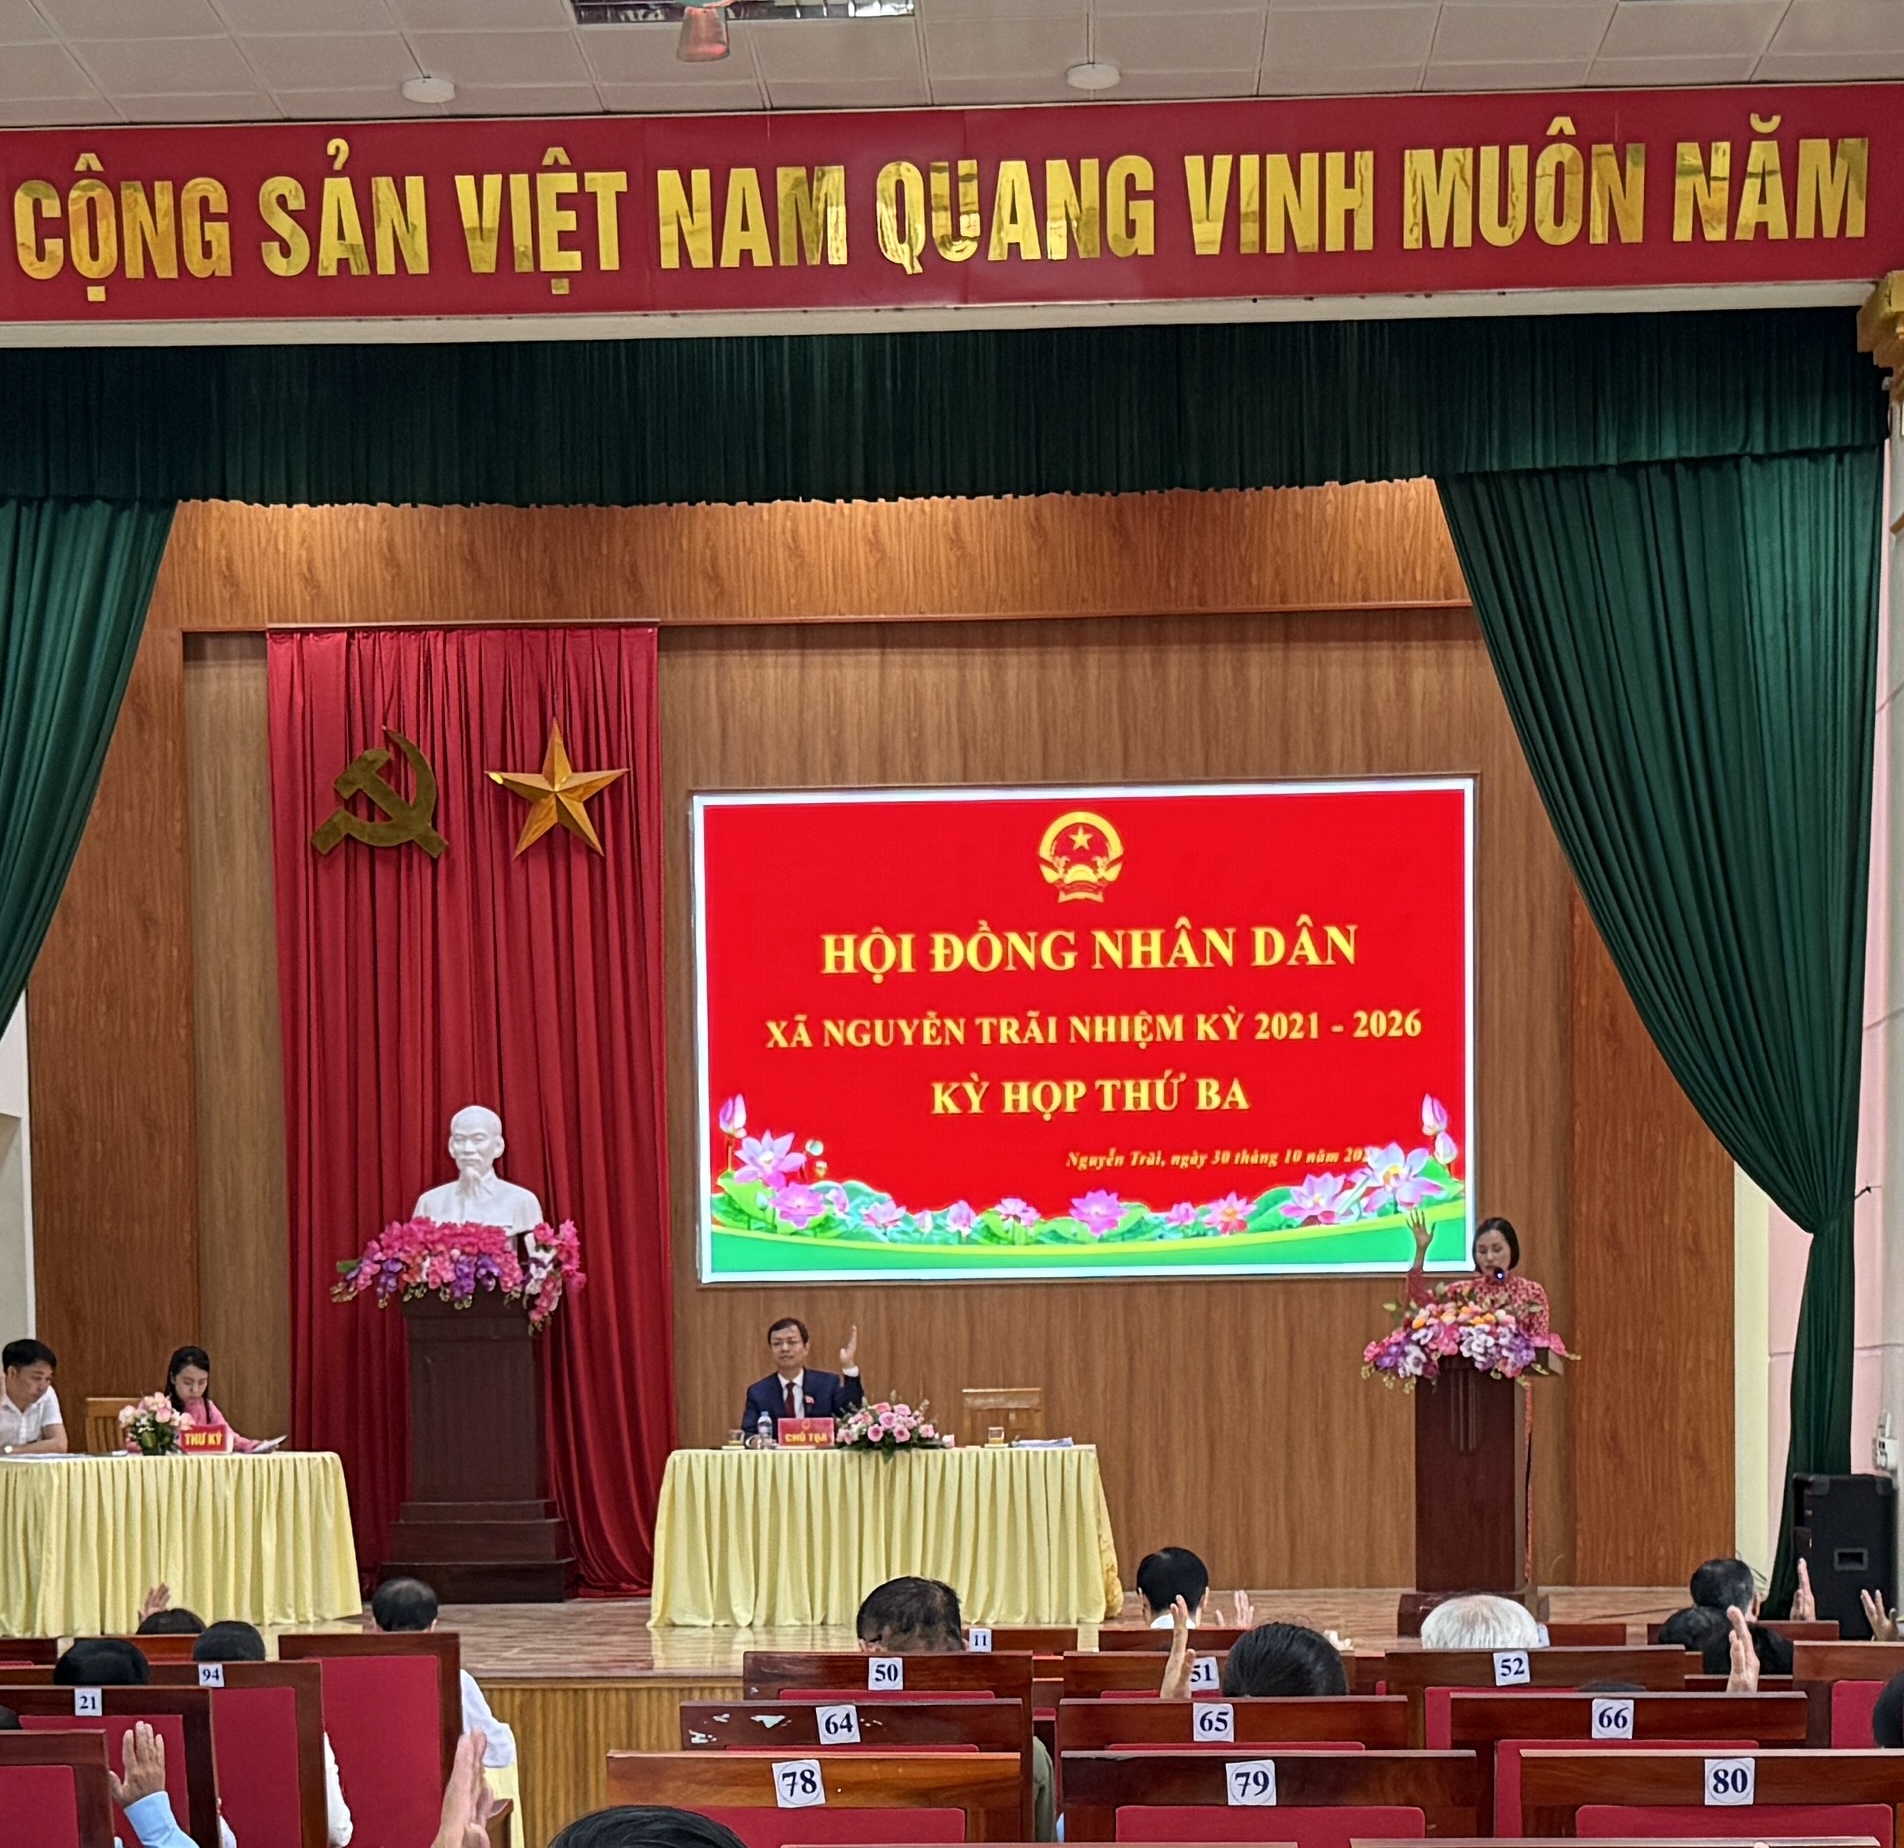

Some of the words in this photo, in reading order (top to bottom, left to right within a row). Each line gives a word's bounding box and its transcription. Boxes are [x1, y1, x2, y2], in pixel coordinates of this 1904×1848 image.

[16, 152, 232, 300] CỘNG
[261, 138, 427, 276] SẢN
[455, 146, 627, 293] VIỆT
[658, 165, 846, 269] NAM
[876, 154, 1155, 276] QUANG
[1184, 151, 1374, 255] VINH
[1403, 117, 1645, 248] MUÔN
[1673, 113, 1867, 241] NĂM
[823, 928, 914, 983] HỘI
[931, 921, 1077, 971] ĐỒNG
[1092, 917, 1234, 968] NHÂN
[1253, 915, 1356, 965] DÂN
[767, 1015, 812, 1047] XÃ
[976, 1011, 1056, 1044] TRÃI
[1070, 1011, 1183, 1049] NHIỆM
[1197, 1006, 1243, 1040] KỲ
[1256, 1013, 1318, 1039] 2021
[1354, 1010, 1421, 1037] 2026
[933, 1073, 988, 1113] KỲ
[1003, 1081, 1086, 1121] HỌP
[1095, 1070, 1186, 1111] THỨ
[1198, 1079, 1249, 1109] BA
[1067, 1148, 1124, 1170] Nguyễn
[1171, 1151, 1207, 1168] ngày
[1212, 1151, 1230, 1164] 30
[1234, 1149, 1278, 1167] tháng
[1285, 1150, 1302, 1163] 10
[1306, 1150, 1339, 1163] năm
[975, 1635, 986, 1646] 11
[875, 1664, 898, 1681] 50
[1191, 1664, 1214, 1683] 51
[1501, 1658, 1524, 1676] 52
[80, 1696, 95, 1709] 21
[825, 1713, 853, 1734] 64
[1200, 1711, 1229, 1731] 65
[1599, 1707, 1628, 1728] 66
[782, 1769, 817, 1797] 78
[1235, 1771, 1269, 1797] 79
[1713, 1768, 1747, 1793] 80
